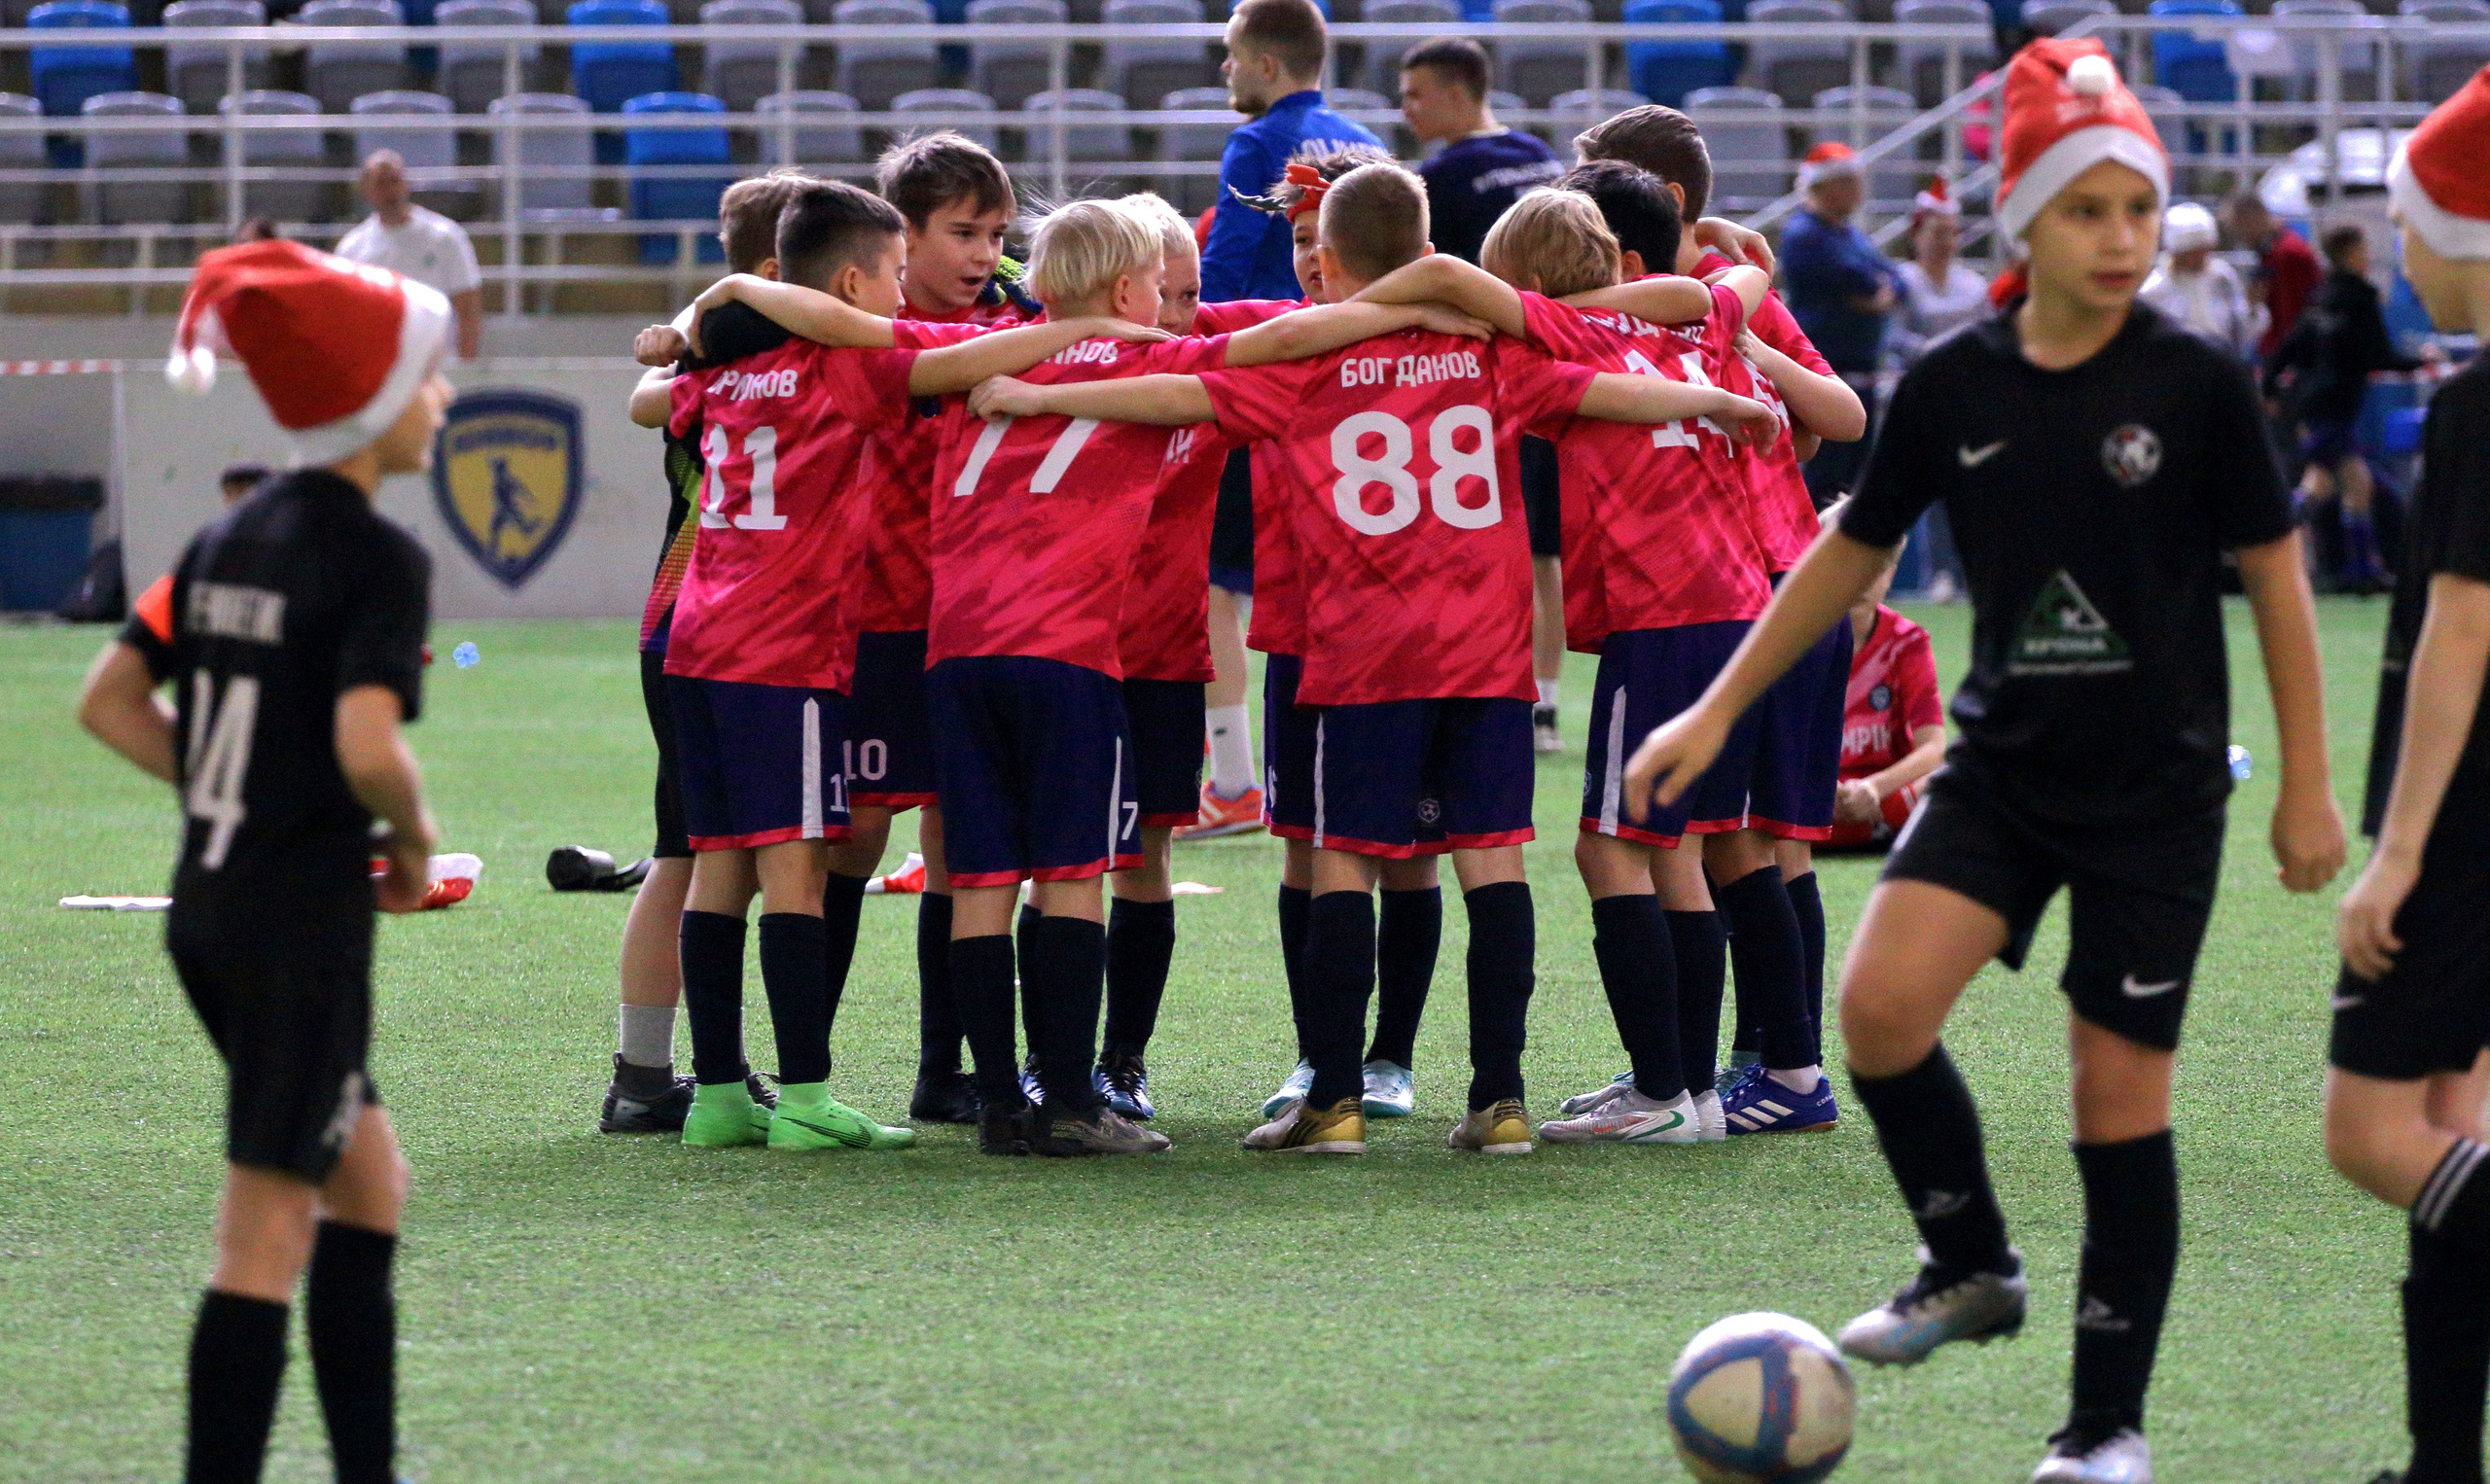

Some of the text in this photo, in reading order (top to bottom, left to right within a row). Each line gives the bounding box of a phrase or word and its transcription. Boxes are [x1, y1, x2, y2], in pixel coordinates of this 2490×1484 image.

[1340, 350, 1481, 388] БОГДАНОВ
[699, 423, 788, 530] 11
[1330, 405, 1503, 536] 88
[185, 669, 261, 869] 14
[842, 739, 887, 780] 10
[1121, 801, 1138, 840] 7
